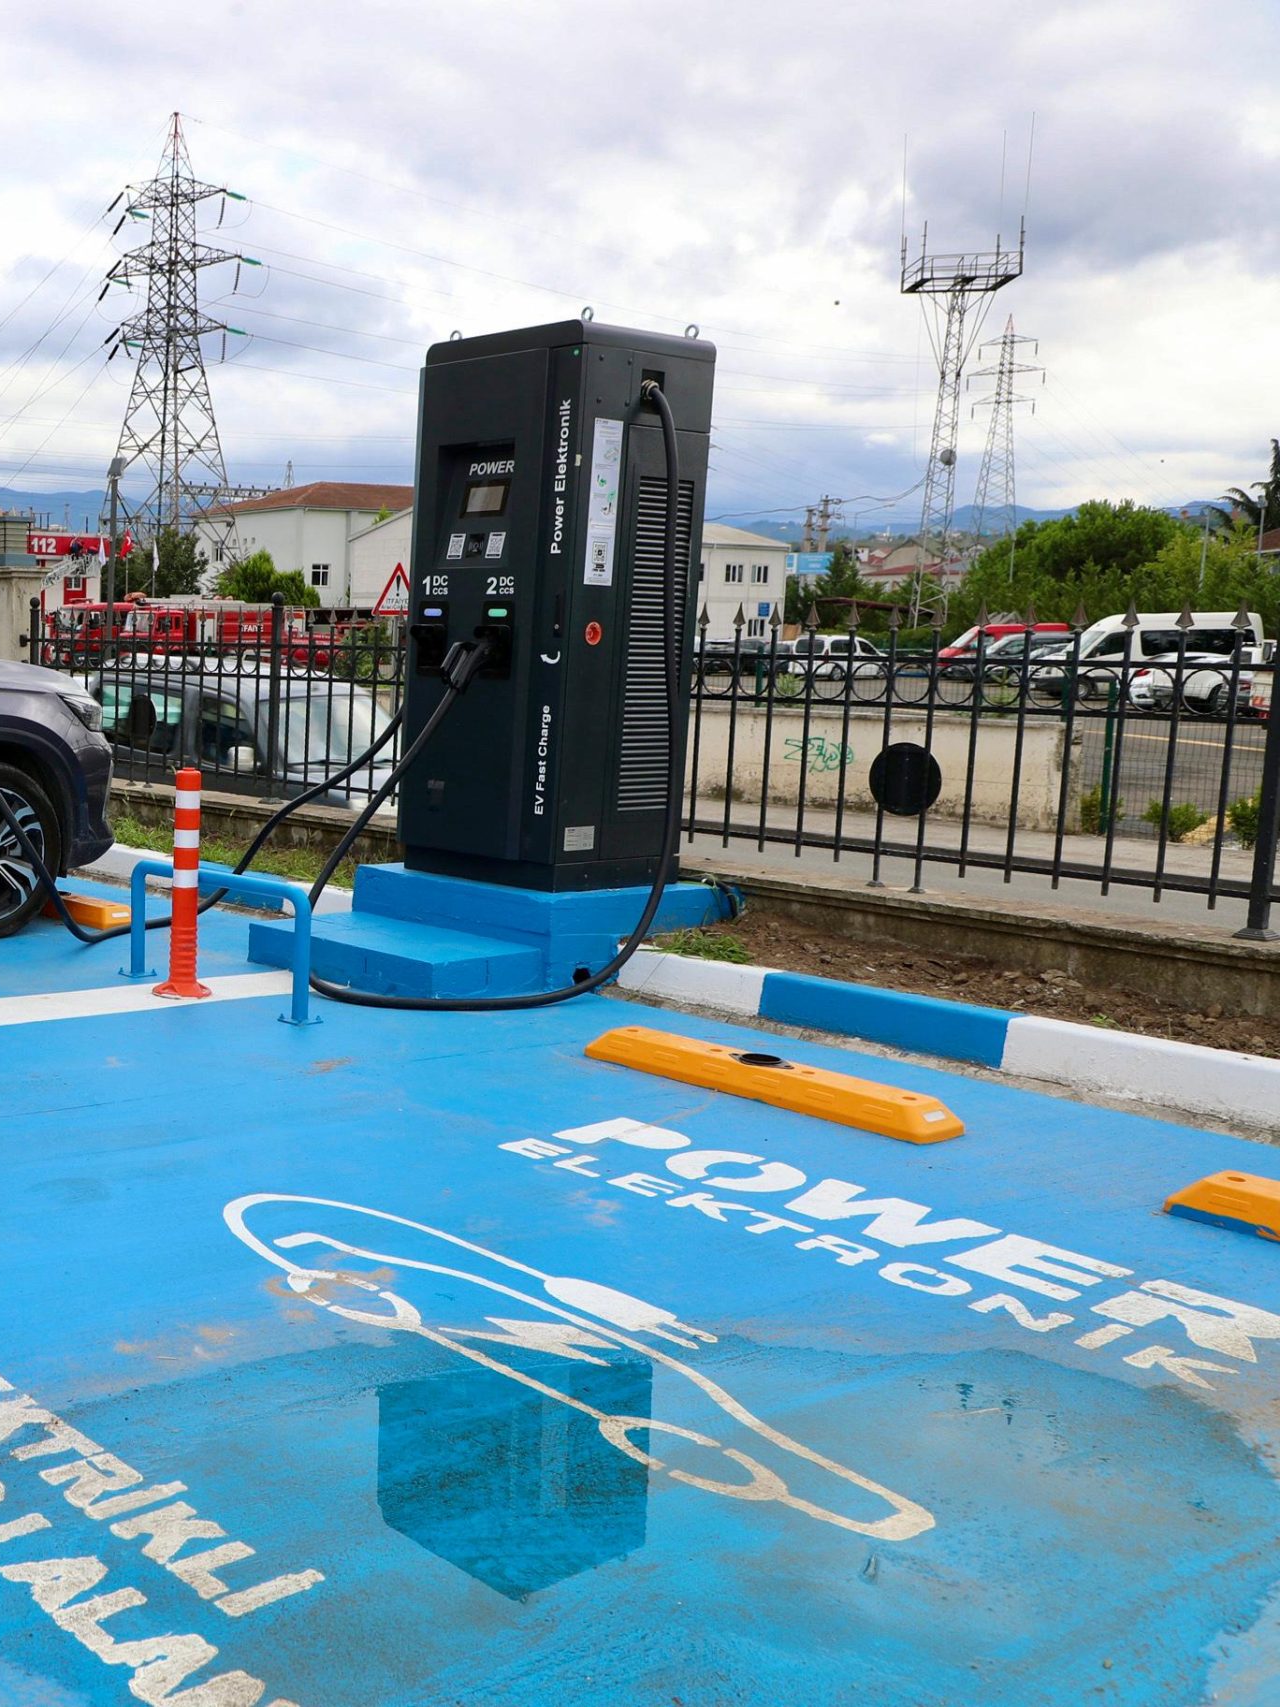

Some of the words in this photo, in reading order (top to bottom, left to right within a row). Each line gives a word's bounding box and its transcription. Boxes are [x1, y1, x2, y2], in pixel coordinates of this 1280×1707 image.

[555, 399, 571, 492] Elektronik
[469, 460, 515, 476] POWER
[550, 497, 565, 554] Power
[32, 537, 57, 553] 112
[422, 575, 431, 595] 1
[433, 575, 448, 586] DC
[433, 587, 448, 595] CCS
[486, 576, 498, 595] 2
[500, 576, 514, 586] DC
[538, 705, 552, 757] Charge
[536, 760, 547, 791] Fast
[534, 795, 544, 815] EV
[552, 1117, 1280, 1363] POWER
